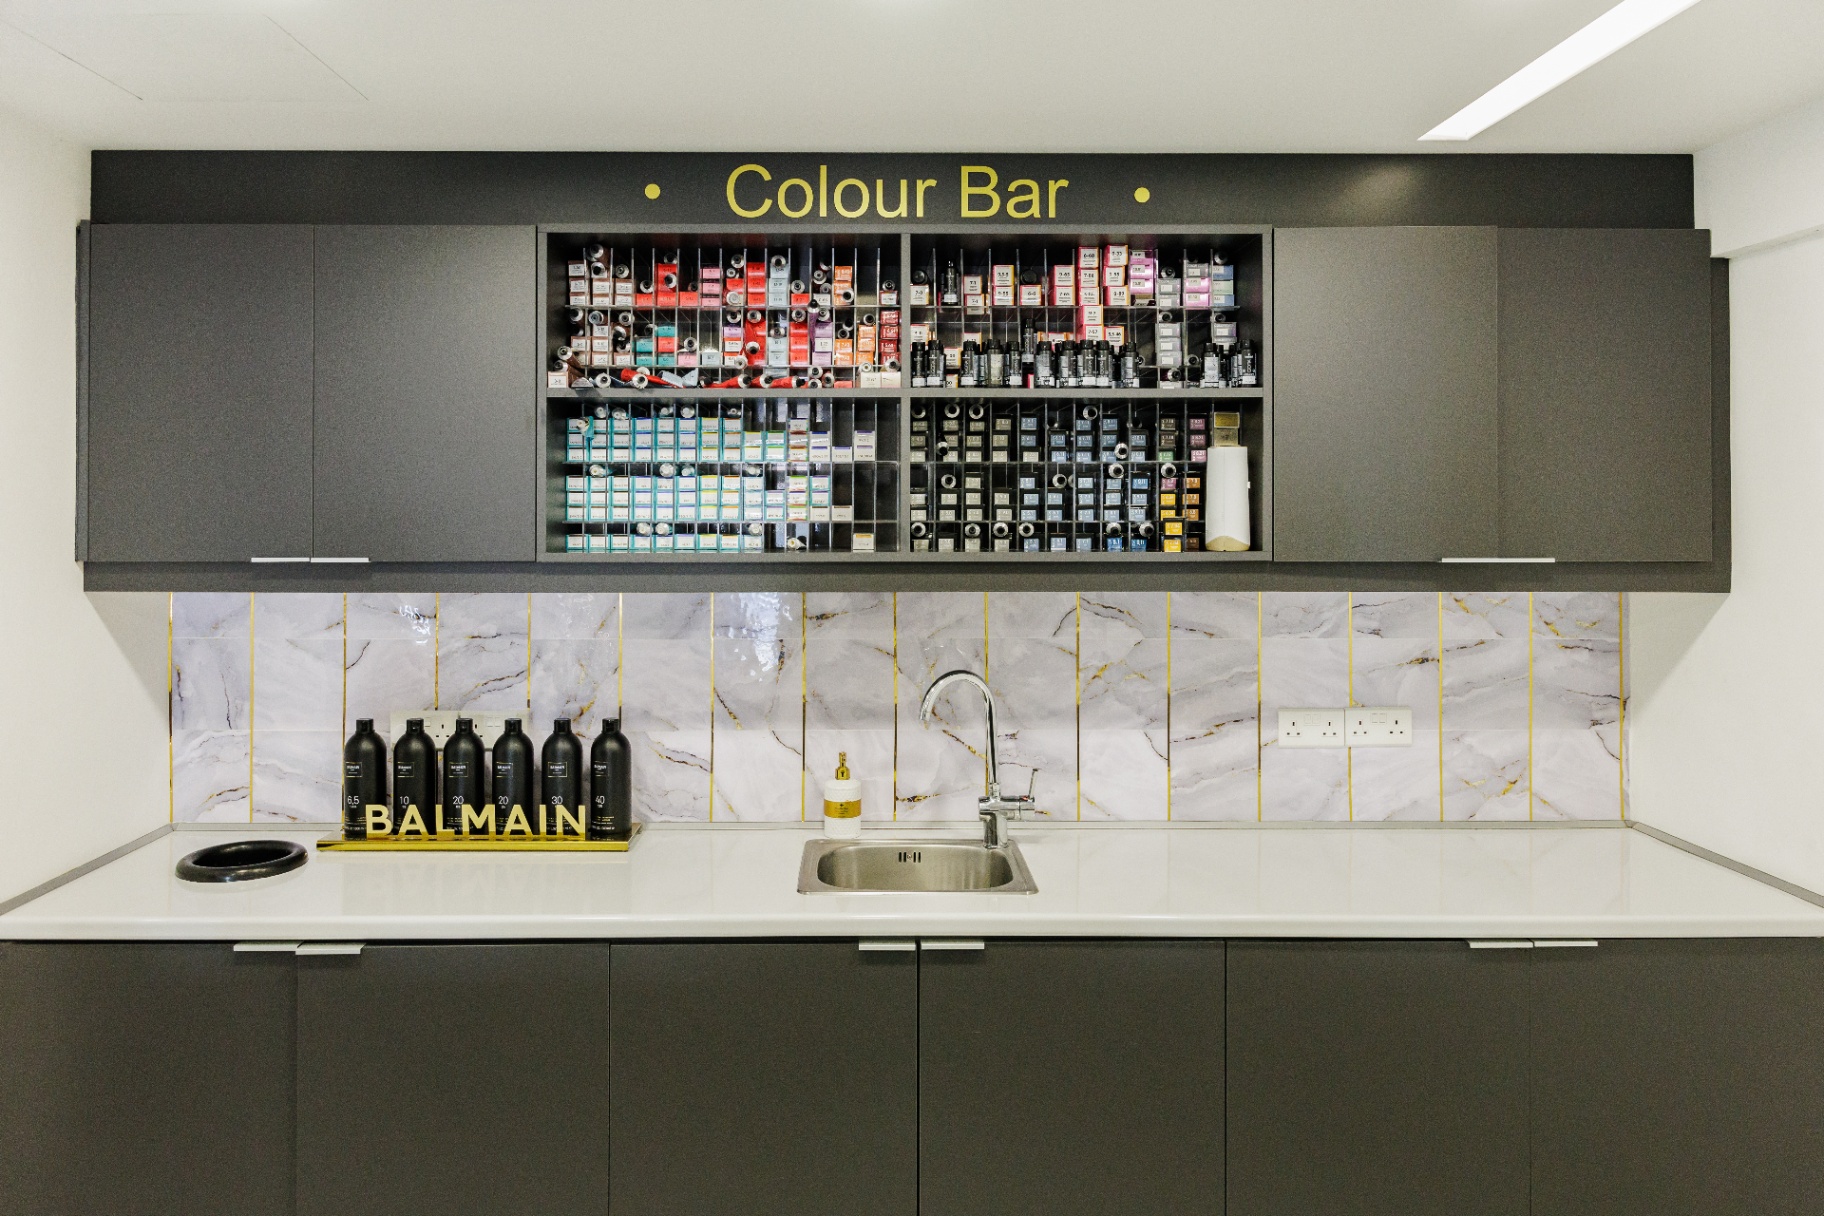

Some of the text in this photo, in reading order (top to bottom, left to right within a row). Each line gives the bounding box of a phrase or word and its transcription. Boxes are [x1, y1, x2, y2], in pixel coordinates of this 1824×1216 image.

[726, 164, 1069, 218] Colour Bar
[399, 795, 410, 805] 10
[452, 795, 464, 805] 20
[498, 795, 509, 805] 20
[551, 795, 564, 805] 30
[595, 795, 606, 805] 40
[365, 804, 586, 838] BALMAIN
